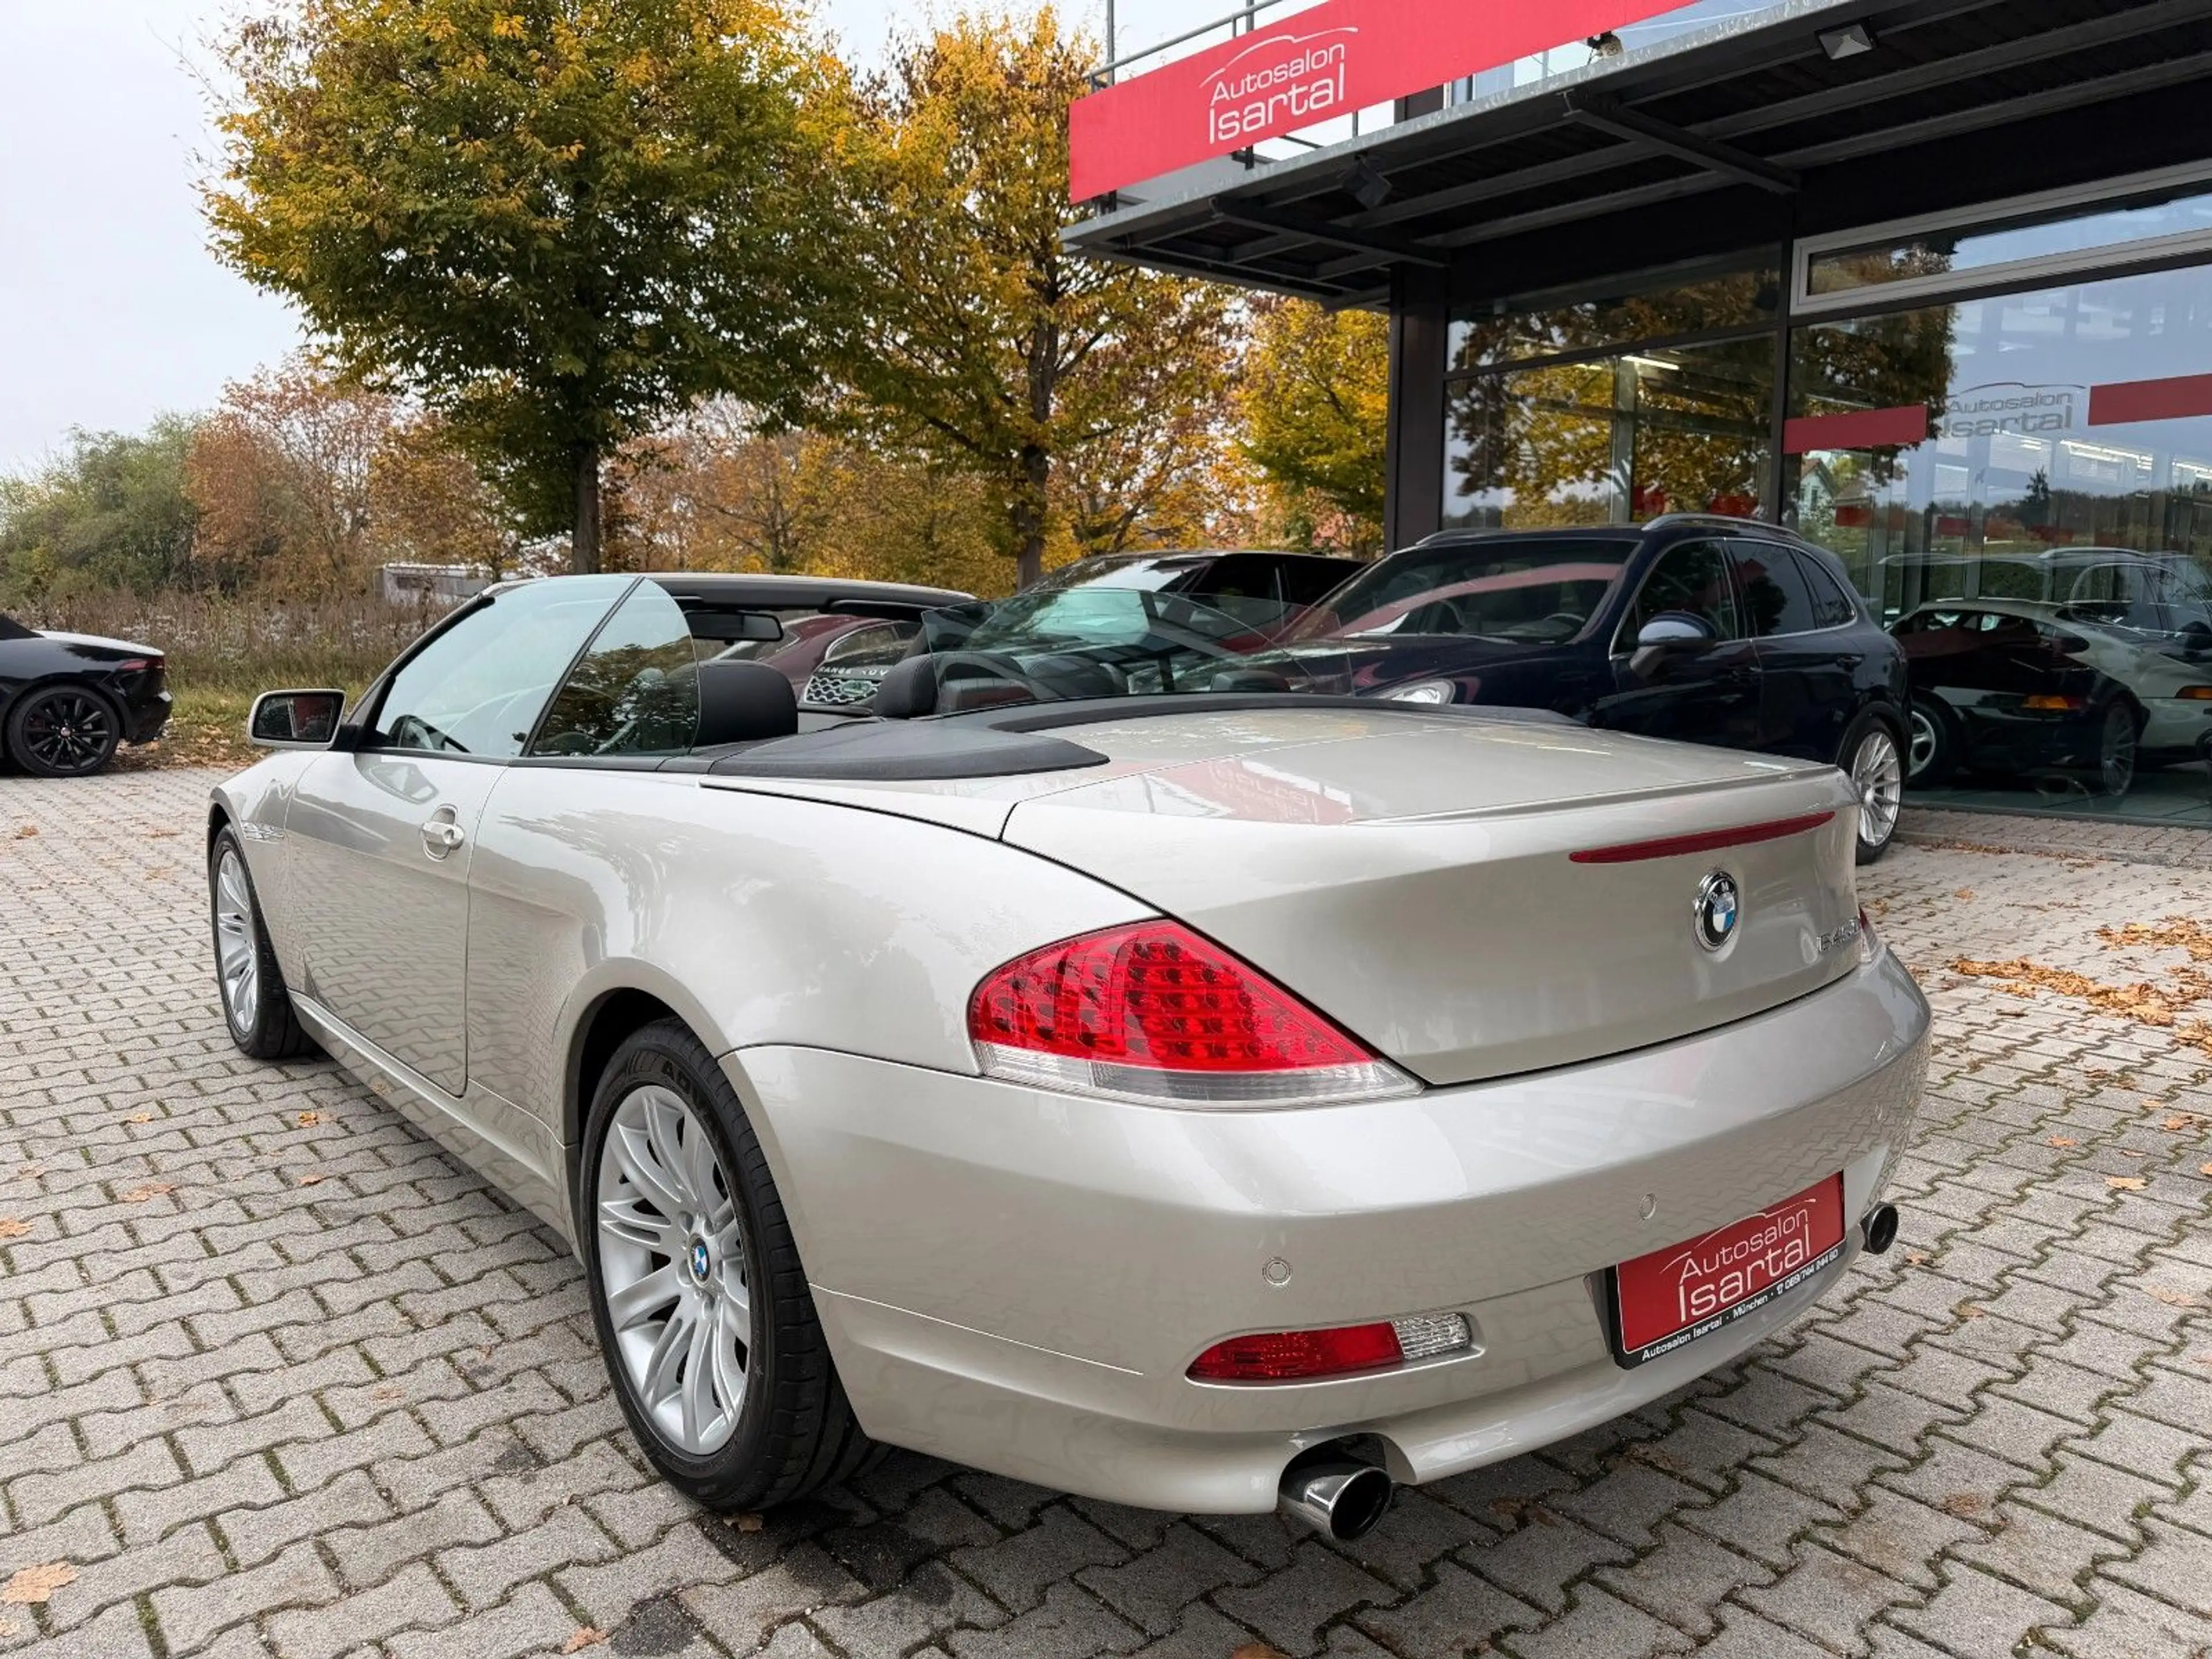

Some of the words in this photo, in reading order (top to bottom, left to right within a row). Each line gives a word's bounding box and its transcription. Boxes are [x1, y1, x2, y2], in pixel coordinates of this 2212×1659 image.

[1210, 43, 1344, 106] Autosalon
[1210, 62, 1344, 144] Isartal
[1944, 405, 2072, 438] Isartal
[1949, 392, 2072, 414] Autosalon
[1679, 1209, 1808, 1284] Autosalon
[1679, 1223, 1809, 1323] Isartal
[1642, 1332, 1691, 1361] Autosalon
[1693, 1315, 1722, 1339] Isartal
[1733, 1294, 1768, 1319] München
